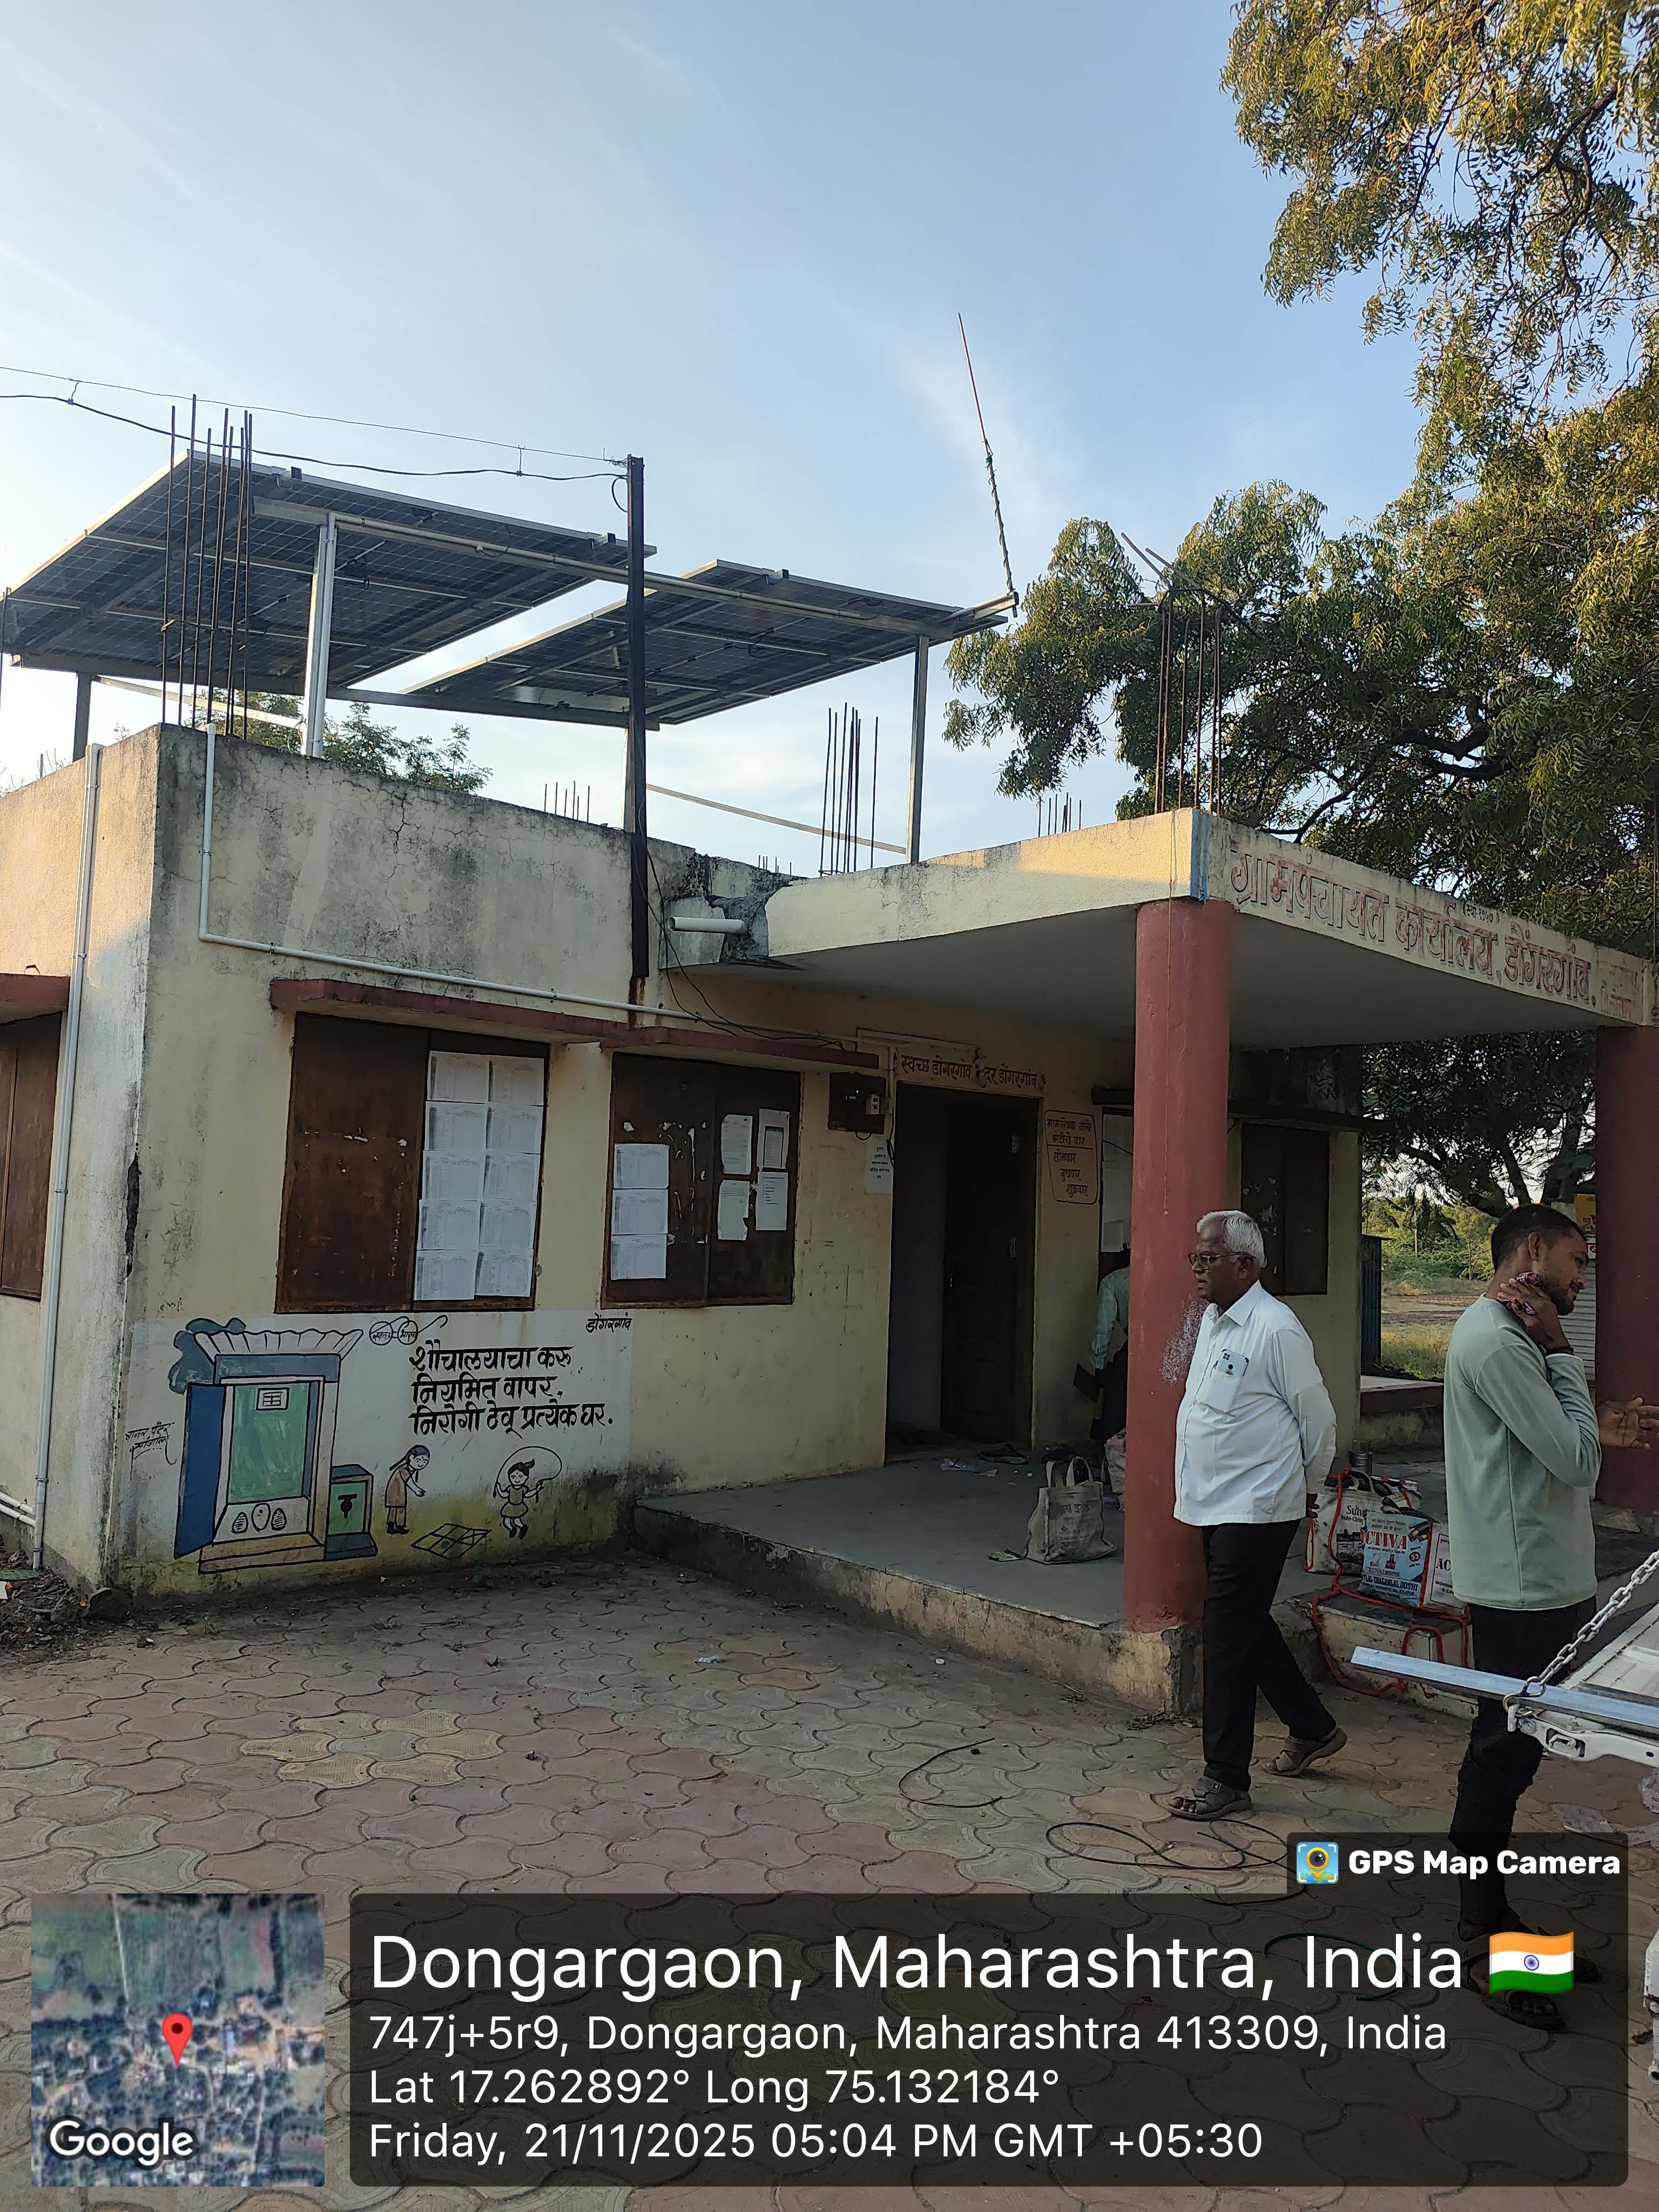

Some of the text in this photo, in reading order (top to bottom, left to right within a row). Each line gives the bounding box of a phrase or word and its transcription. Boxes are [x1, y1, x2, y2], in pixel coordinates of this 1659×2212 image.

[1230, 849, 1389, 942] ग्रामपंचायत
[901, 1054, 929, 1074] स्वच्छ
[999, 1063, 1038, 1088] डोंगरगांव
[1074, 1136, 1085, 1145] वार
[1054, 1149, 1076, 1164] सोमवार
[1060, 1169, 1082, 1182] बुधवार
[1066, 1184, 1089, 1198] शुक्रवार
[585, 1312, 633, 1333] डोंगरगांव
[409, 1340, 540, 1373] शौचालयाचा
[411, 1371, 501, 1405] नियमित
[408, 1401, 486, 1435] निरोगी
[486, 1400, 523, 1439] ठेवू
[521, 1398, 582, 1430] प्रत्येक
[1400, 1580, 1419, 1591] DOSHI
